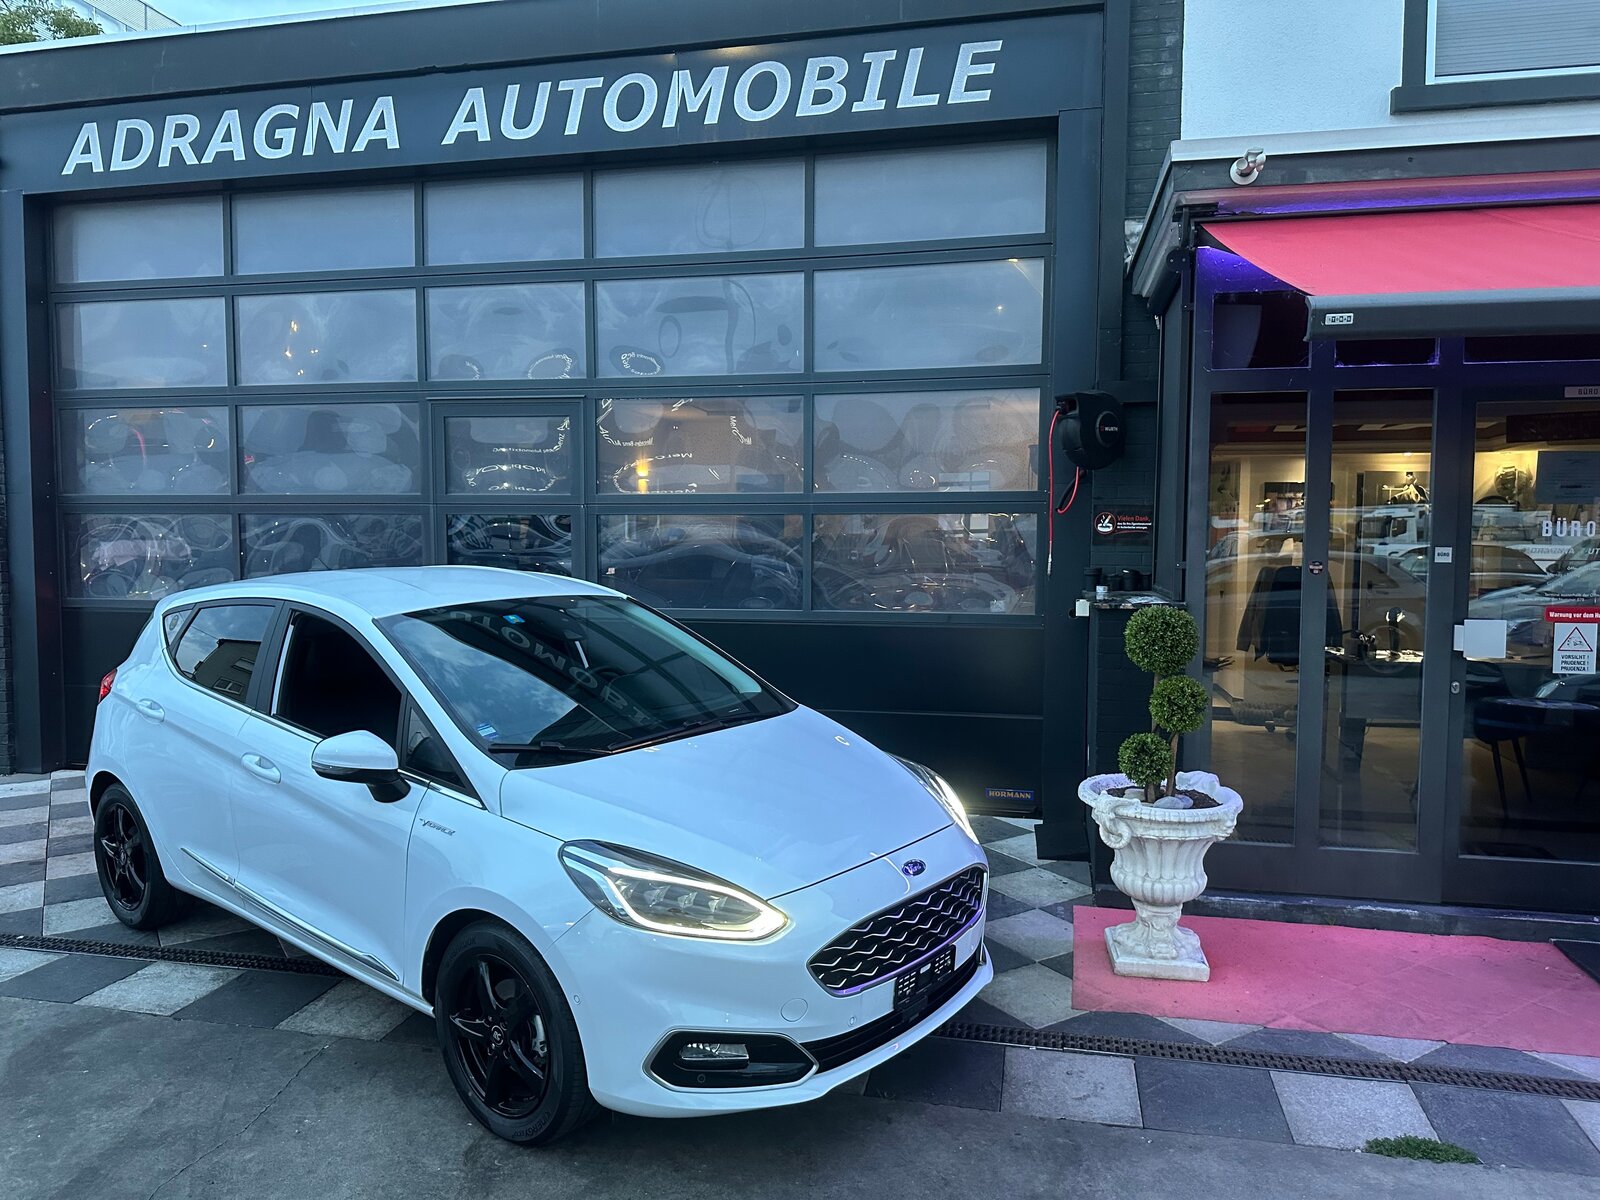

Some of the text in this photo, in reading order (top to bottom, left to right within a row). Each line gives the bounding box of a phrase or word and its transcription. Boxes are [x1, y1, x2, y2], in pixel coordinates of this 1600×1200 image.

[61, 39, 1003, 175] ADRAGNA AUTOMOBILE
[1542, 518, 1596, 537] BÜRO
